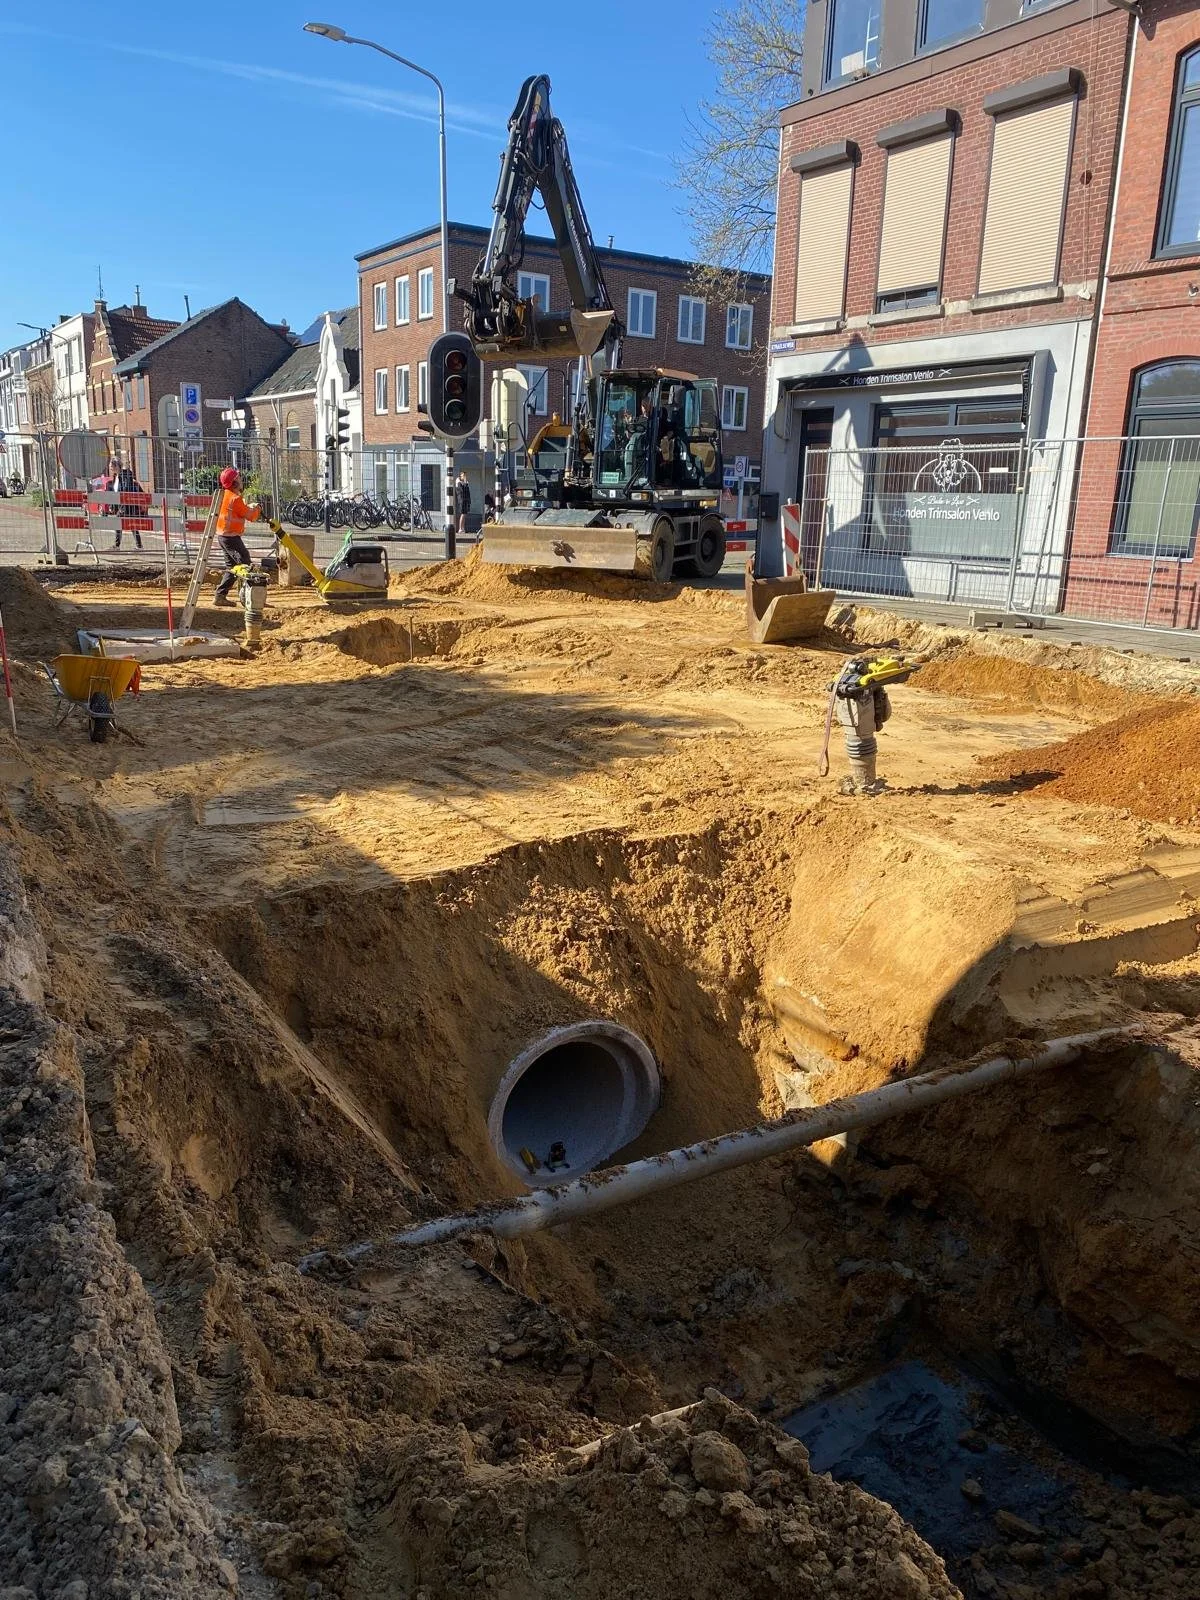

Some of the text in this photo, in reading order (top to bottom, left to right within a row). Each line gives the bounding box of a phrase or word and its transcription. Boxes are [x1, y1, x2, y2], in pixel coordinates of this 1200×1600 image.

[853, 370, 934, 385] Honden Trimsalon Venlo
[927, 507, 971, 520] Trimsalon
[972, 508, 1000, 521] Venlo
